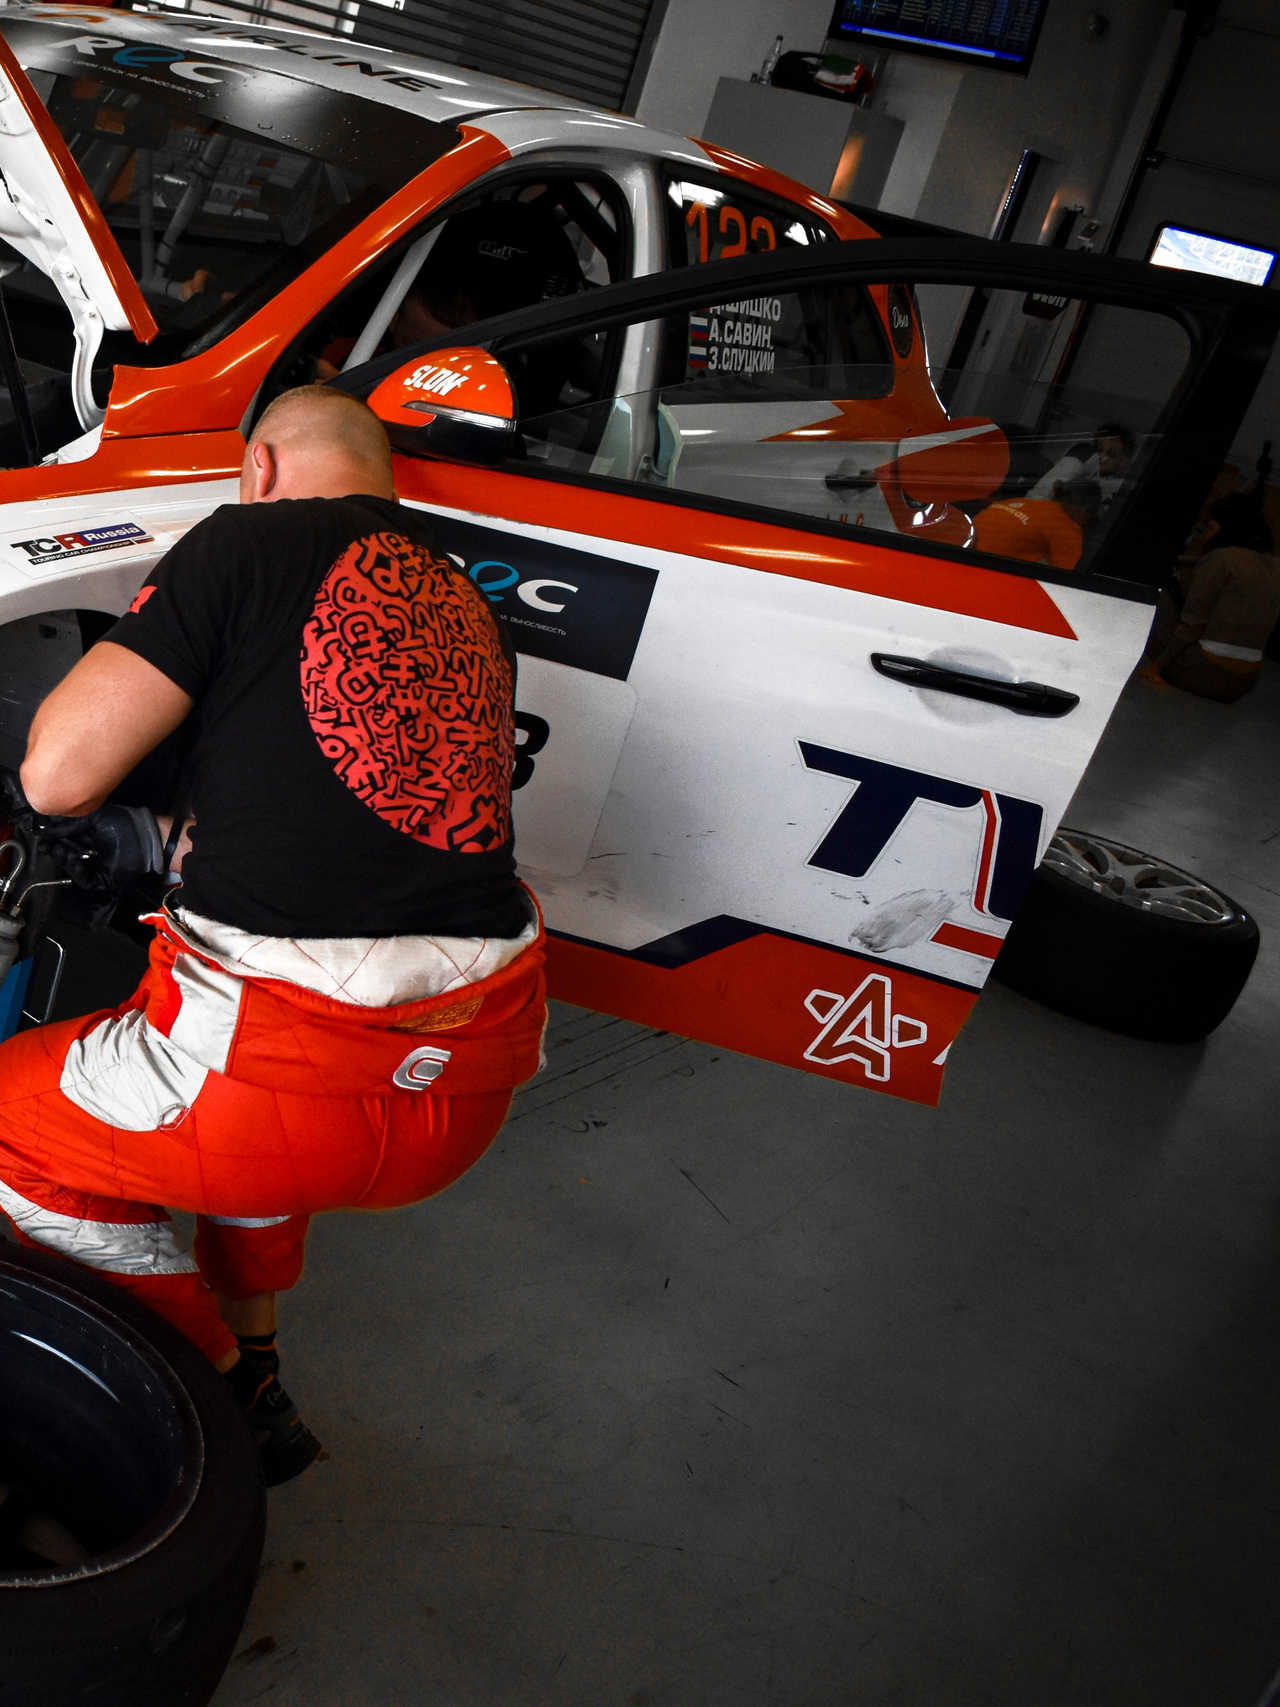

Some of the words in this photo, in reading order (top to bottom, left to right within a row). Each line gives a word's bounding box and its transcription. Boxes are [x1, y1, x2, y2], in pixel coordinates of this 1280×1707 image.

[166, 22, 443, 93] AIRLINE
[403, 365, 470, 396] SLON
[10, 532, 90, 557] TCR
[83, 525, 142, 542] Russia
[32, 553, 64, 565] TOURING
[65, 549, 80, 558] CAR
[80, 540, 132, 555] CHAMPIONSHIP
[510, 616, 567, 636] ВЫНОСЛИВОСТЬ
